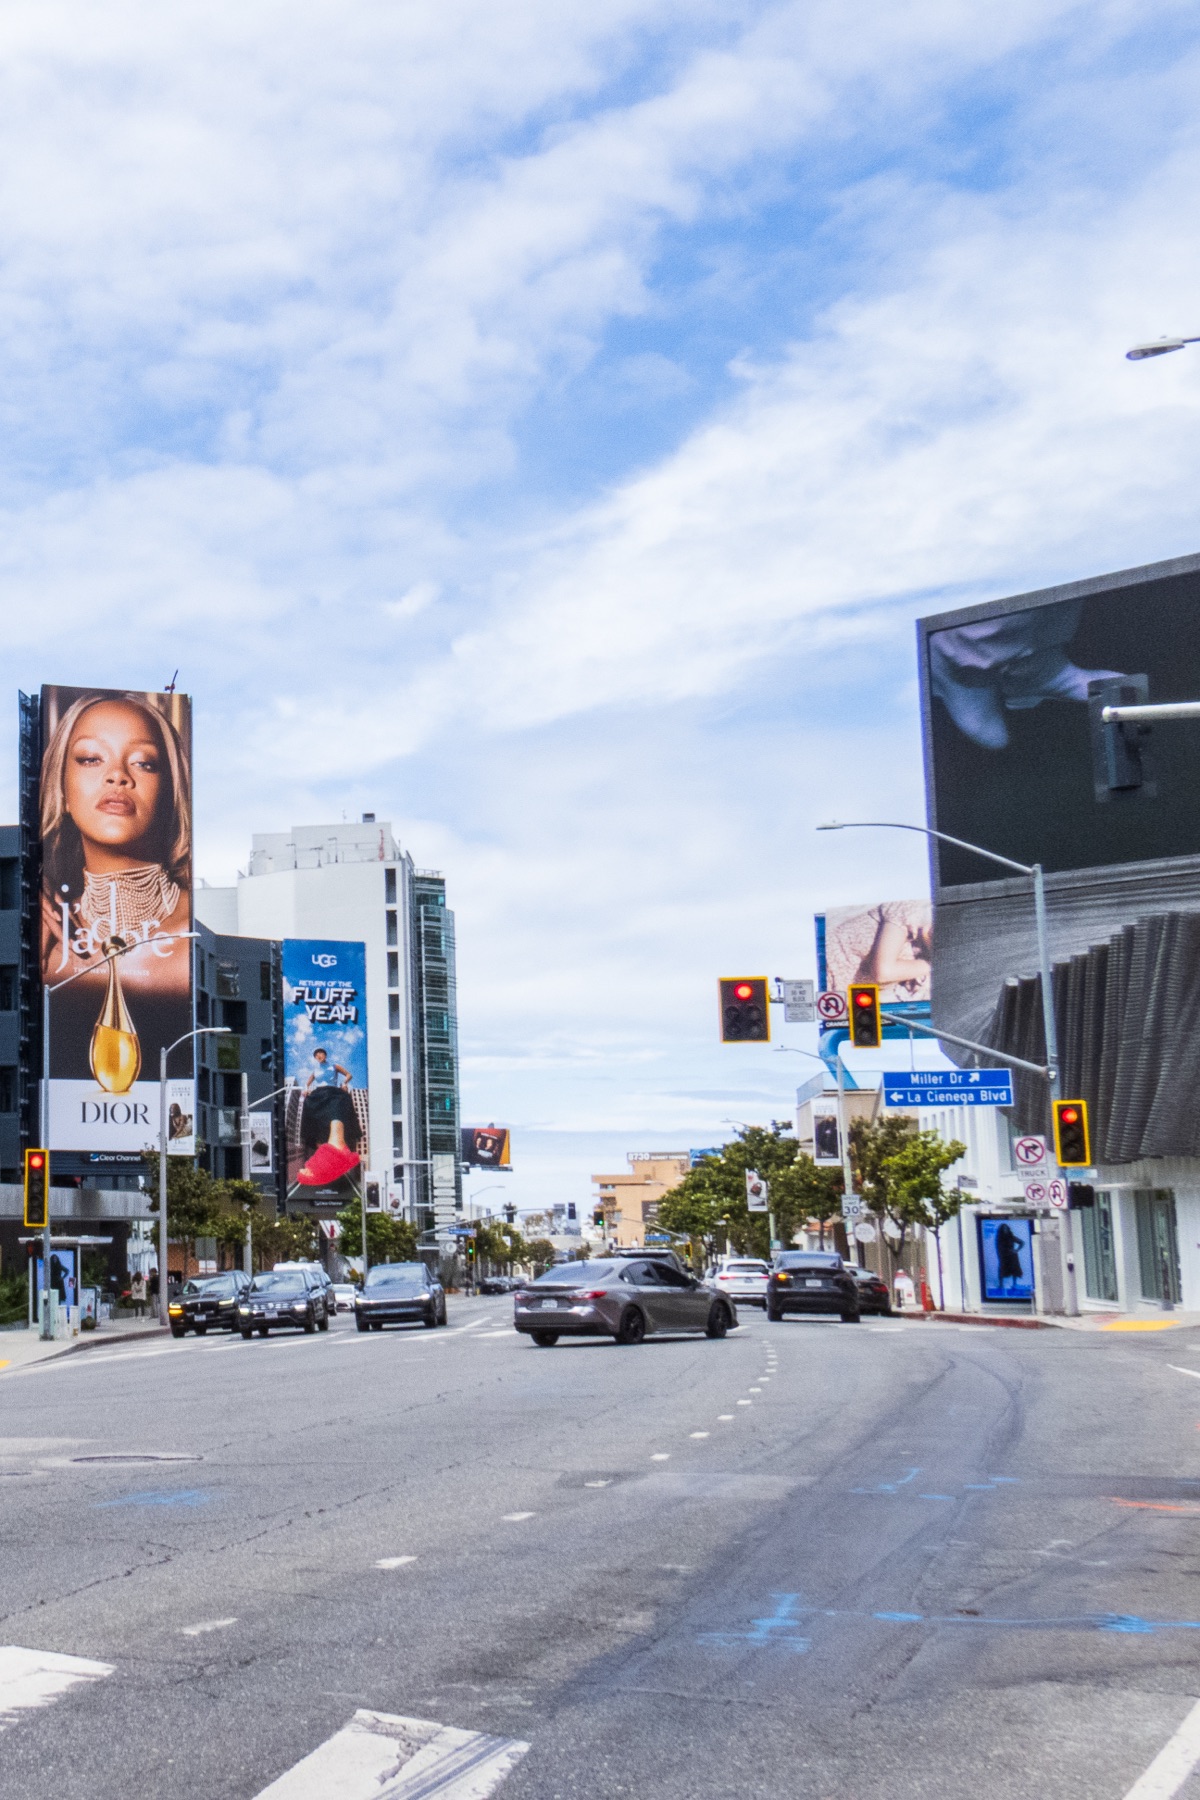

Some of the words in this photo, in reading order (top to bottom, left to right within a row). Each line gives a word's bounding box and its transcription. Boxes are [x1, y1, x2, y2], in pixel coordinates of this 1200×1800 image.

[311, 953, 337, 968] UGG
[299, 979, 325, 987] RETURN
[338, 980, 352, 988] THE
[293, 987, 355, 1004] FLUFF
[305, 1005, 357, 1022] YEAH
[910, 1073, 943, 1085] Miller
[950, 1073, 963, 1084] Dr
[907, 1091, 921, 1102] La
[927, 1090, 975, 1105] Cienega
[980, 1090, 1007, 1101] Blvd
[81, 1101, 151, 1125] DIOR
[116, 1154, 141, 1162] Channel
[844, 1206, 859, 1214] 30
